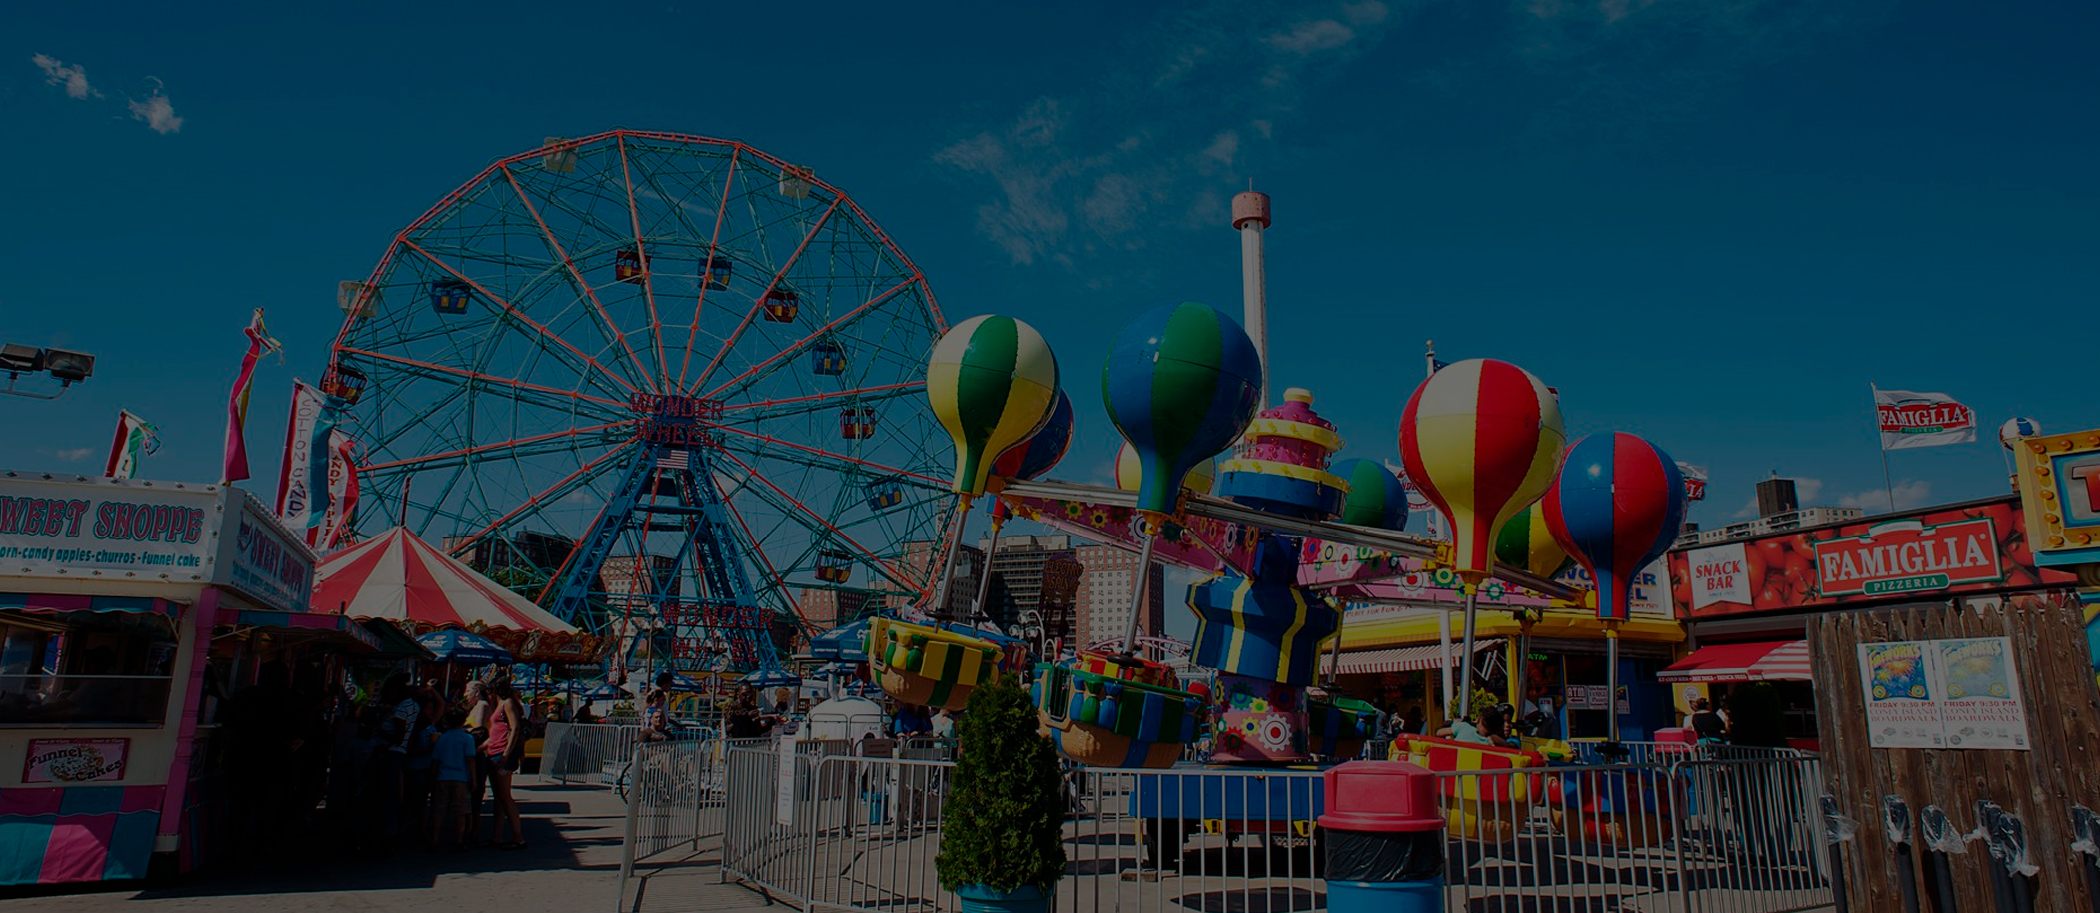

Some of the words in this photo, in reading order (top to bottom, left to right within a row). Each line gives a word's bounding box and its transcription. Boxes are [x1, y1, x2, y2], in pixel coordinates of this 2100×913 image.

[630, 392, 724, 420] WONDER
[1880, 406, 1966, 427] FAMIGLIA
[294, 398, 311, 462] COTTON
[634, 420, 712, 447] WHEEL
[93, 500, 204, 544] SHOPPE
[177, 554, 200, 568] cake
[1696, 560, 1741, 578] SNACK
[1821, 534, 1989, 582] FAMIGLIA
[1707, 576, 1733, 590] BAR
[1874, 577, 1938, 592] PIZZERIA
[661, 602, 775, 630] WONDER
[672, 636, 759, 662] WHEL
[1567, 685, 1587, 697] ATM
[1945, 714, 2020, 722] BOARDWALK
[29, 747, 82, 769] Funnel
[75, 759, 122, 781] Cakes
